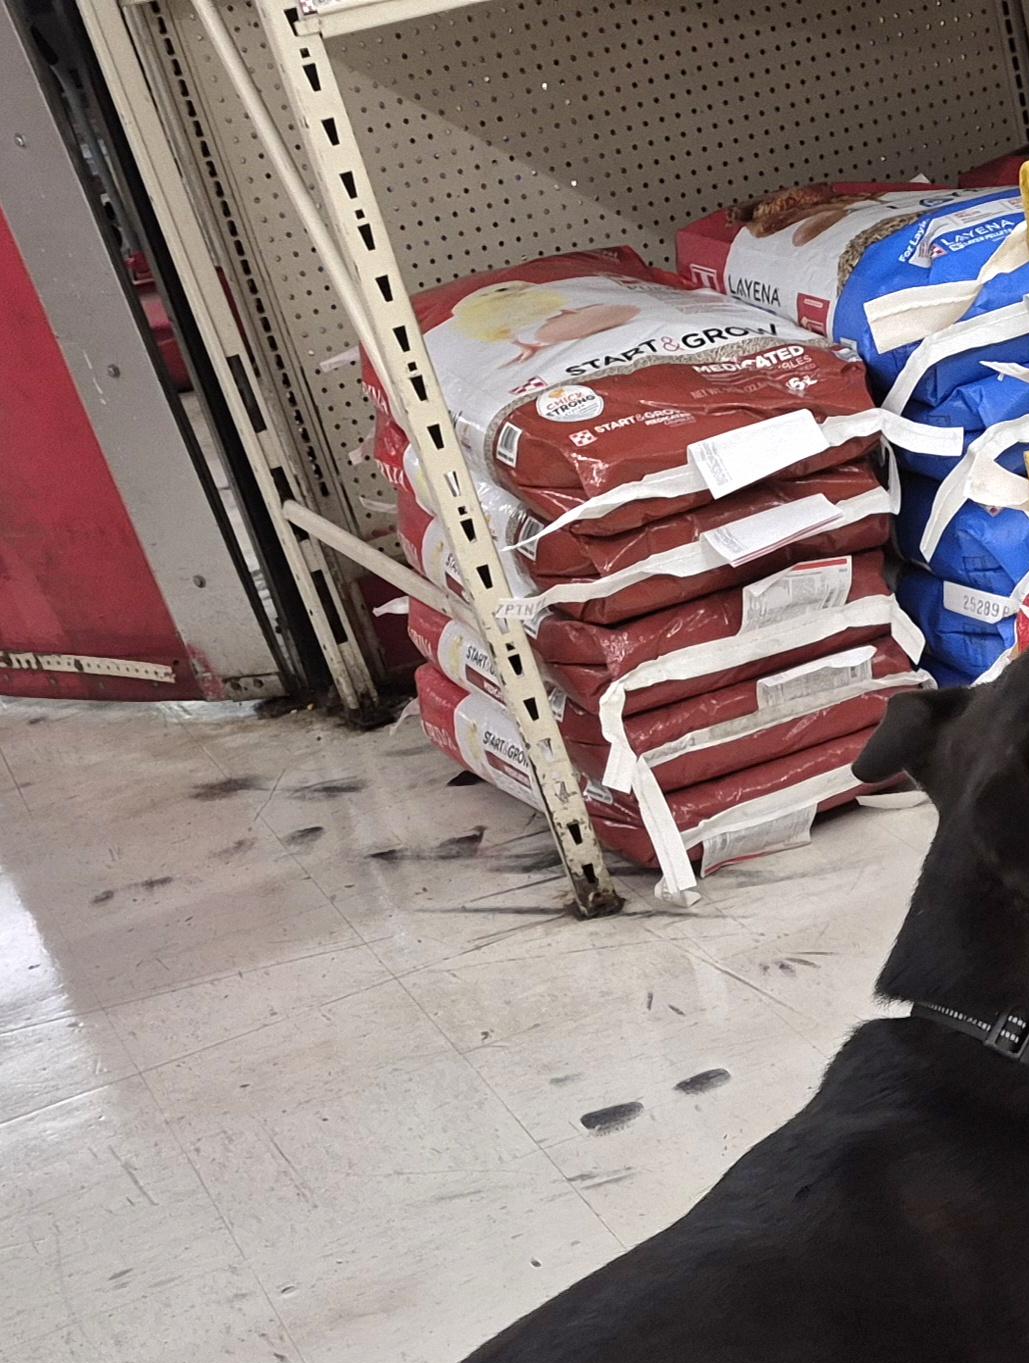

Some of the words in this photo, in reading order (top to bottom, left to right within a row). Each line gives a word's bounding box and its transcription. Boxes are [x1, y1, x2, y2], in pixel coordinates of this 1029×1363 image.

[940, 219, 1016, 246] LAYENA
[728, 274, 782, 308] LAYENA
[691, 345, 806, 374] MEDICATED
[546, 391, 583, 411] CHICK
[963, 594, 1000, 618] 25289
